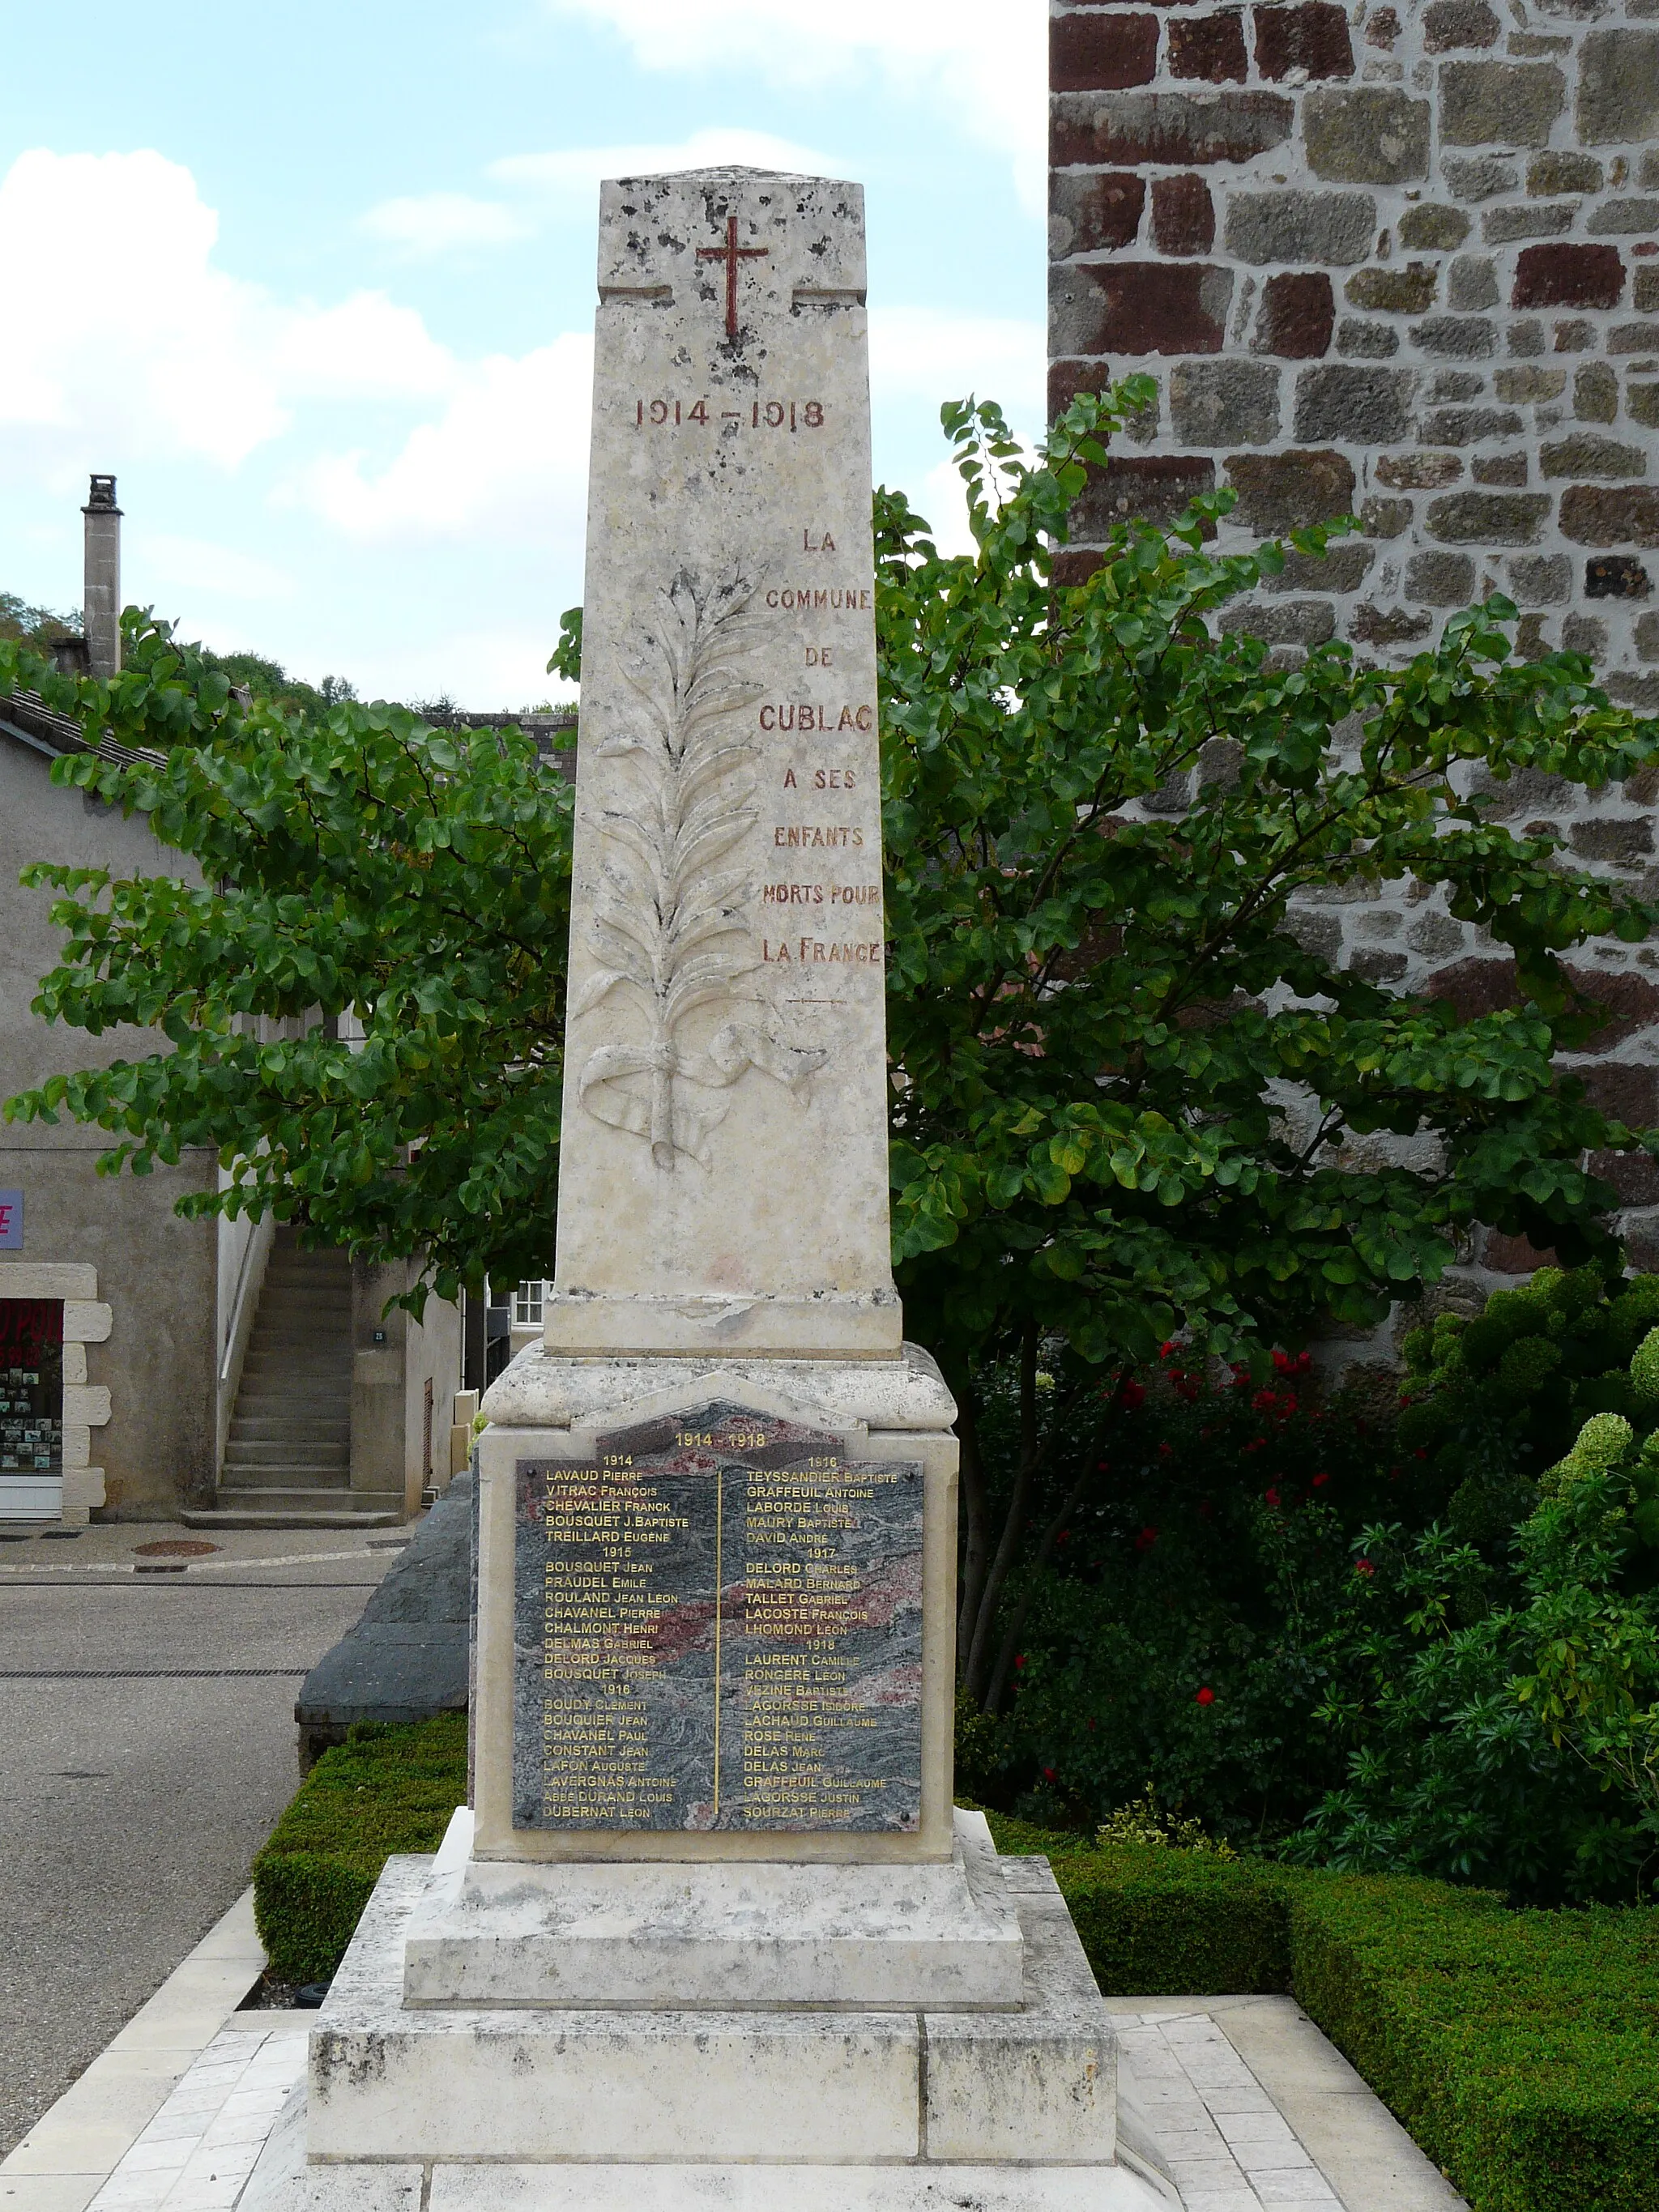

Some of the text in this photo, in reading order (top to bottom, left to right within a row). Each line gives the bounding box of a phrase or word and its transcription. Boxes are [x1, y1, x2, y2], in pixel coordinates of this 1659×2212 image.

[804, 529, 836, 552] LA
[766, 590, 872, 609] COMMUNE
[805, 647, 833, 667] DE
[760, 705, 872, 731] CUBLAC
[783, 769, 856, 789] A SES
[775, 827, 864, 846] ENFANTS
[763, 884, 881, 905] MORTS POUR
[763, 937, 881, 962] LA FRANCE
[676, 1433, 712, 1446] 1914
[728, 1434, 765, 1447] 1918
[603, 1455, 632, 1465] 1914
[808, 1457, 836, 1468] 1916
[546, 1471, 642, 1481] LAVAUD PIERRE
[747, 1472, 898, 1482] TEYSSANDIER BAPTISTE
[547, 1485, 657, 1497] VITRAC FRANÇOIS
[747, 1487, 873, 1498] GRAFFEUIL ANTOINE
[545, 1501, 670, 1511] CHEVALIER FRANCK
[747, 1502, 849, 1513] LABORDE LOUIS
[546, 1516, 620, 1527] BOUSQUET
[747, 1518, 851, 1528] MAURY BAPTISTE
[545, 1532, 620, 1542] TREILLARD
[747, 1533, 786, 1543] DAVID
[603, 1547, 631, 1557] 1915
[808, 1549, 835, 1558] 1917
[545, 1562, 652, 1573] BOUSQUET JEAN
[747, 1563, 857, 1574] DELORD CHARLES
[545, 1578, 646, 1588] PRAUDEL EMILE
[746, 1579, 859, 1589] MALARD BERNARD
[545, 1592, 609, 1603] ROULAND
[615, 1592, 643, 1603] JEAN
[746, 1594, 847, 1605] TALLET GABRIEL
[545, 1608, 660, 1618] CHAVANEL PIERRE
[746, 1609, 808, 1620] LACOSTE
[544, 1623, 658, 1634] CHALMONT HENRI
[746, 1624, 812, 1634] LHOMOND
[544, 1639, 652, 1649] DELMAS GABRIEL
[807, 1640, 834, 1650] 1918
[544, 1654, 655, 1664] DELORD JACQUES
[746, 1655, 859, 1665] LAURENT CAMILLE
[544, 1669, 666, 1679] BOUSQUET JOSEPH
[603, 1685, 629, 1694] 1916
[747, 1686, 848, 1695] VEZINE BAPTISTE
[544, 1699, 590, 1711] BOUDY
[745, 1701, 865, 1711] LAGORSSE ISIDORE
[544, 1715, 647, 1725] BOUQUIER JEAN
[745, 1716, 876, 1726] LACHAUD GUILLAUME
[544, 1731, 647, 1741] CHAVANEL PAUL
[745, 1732, 780, 1741] ROSE
[544, 1745, 648, 1757] CONSTANT JEAN
[744, 1746, 825, 1756] DELAS MARC
[544, 1761, 645, 1771] LAFON AUGUSTE
[744, 1762, 821, 1771] DELAS JEAN
[544, 1776, 676, 1787] LAVERGNAS ANTOINE
[744, 1777, 886, 1788] GRAFFEUIL GUILLAUME
[578, 1792, 634, 1802] DURAND
[640, 1792, 672, 1802] LOUIS
[744, 1792, 859, 1802] LAGORSSE JUSTIN
[543, 1807, 616, 1818] DUBERNAT
[744, 1807, 850, 1818] SOURZAT PIERRE
